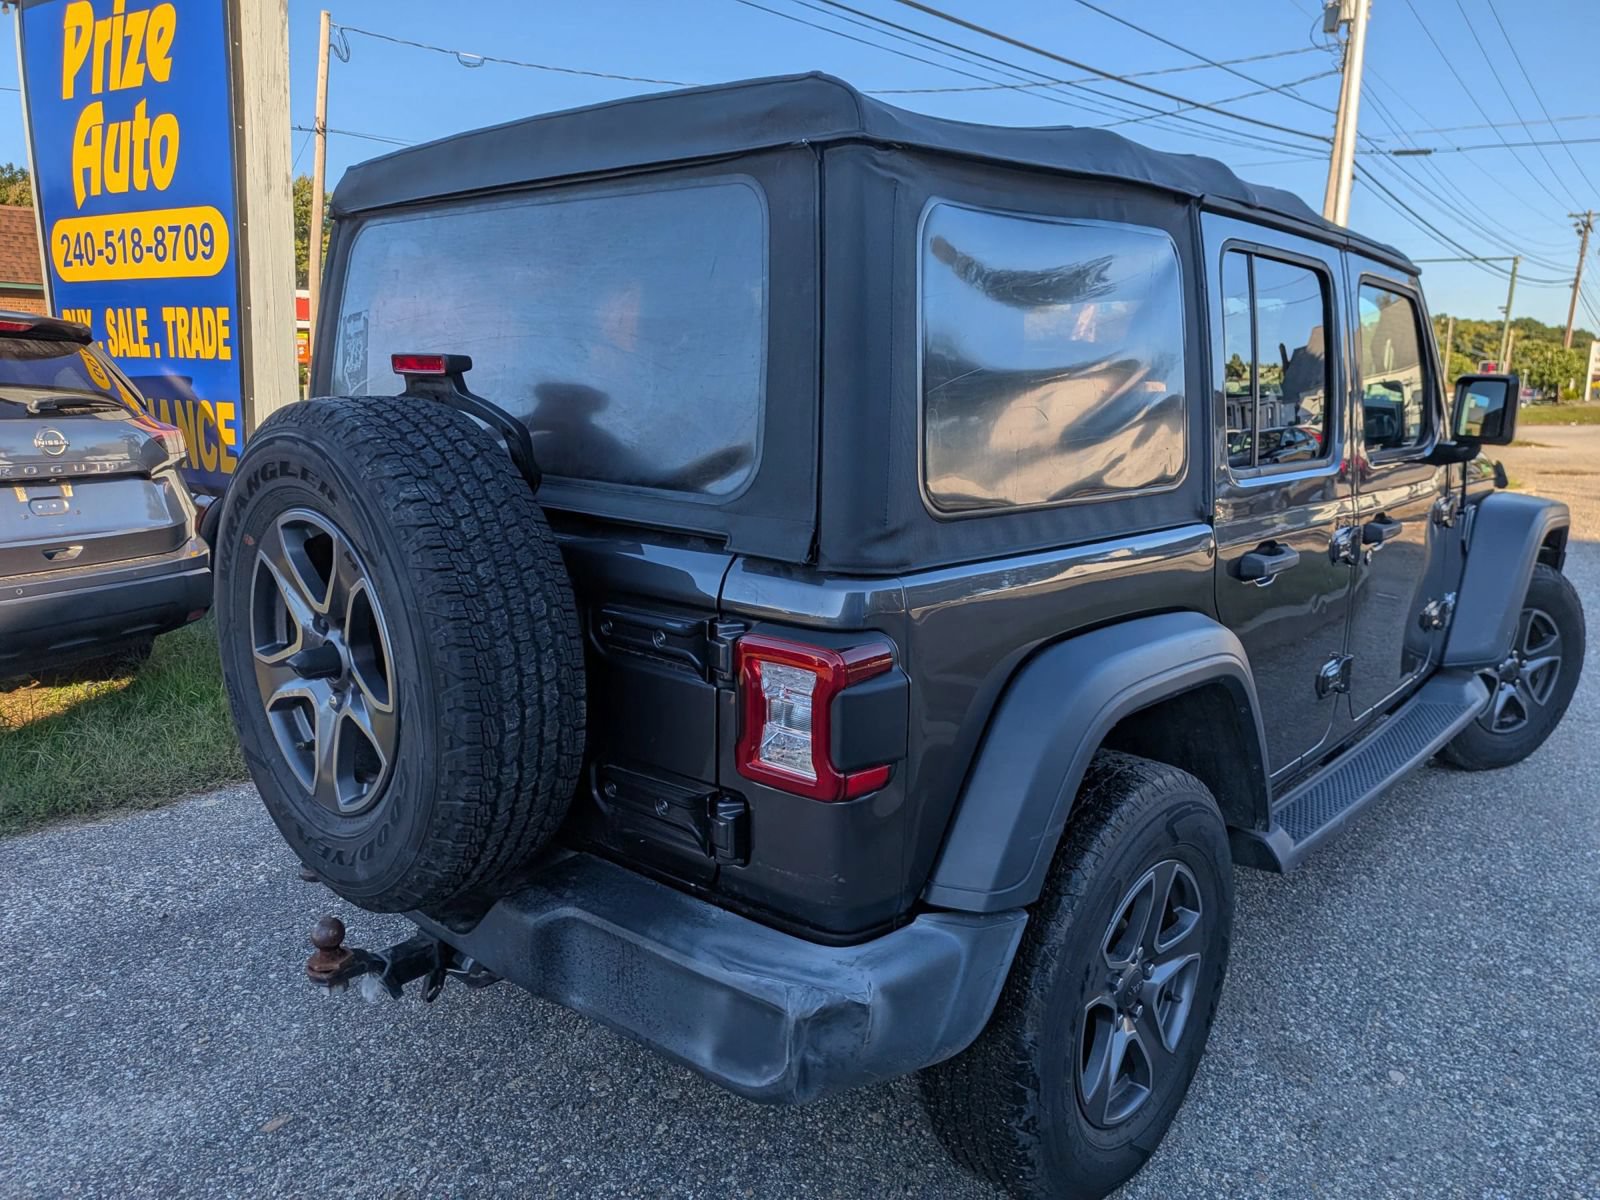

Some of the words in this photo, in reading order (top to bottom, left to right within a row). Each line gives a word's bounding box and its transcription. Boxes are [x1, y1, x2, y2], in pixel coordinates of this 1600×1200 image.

[62, 0, 176, 100] Prize
[72, 98, 180, 209] Auto
[61, 222, 215, 268] 240-518-8709
[162, 306, 231, 360] TRADE
